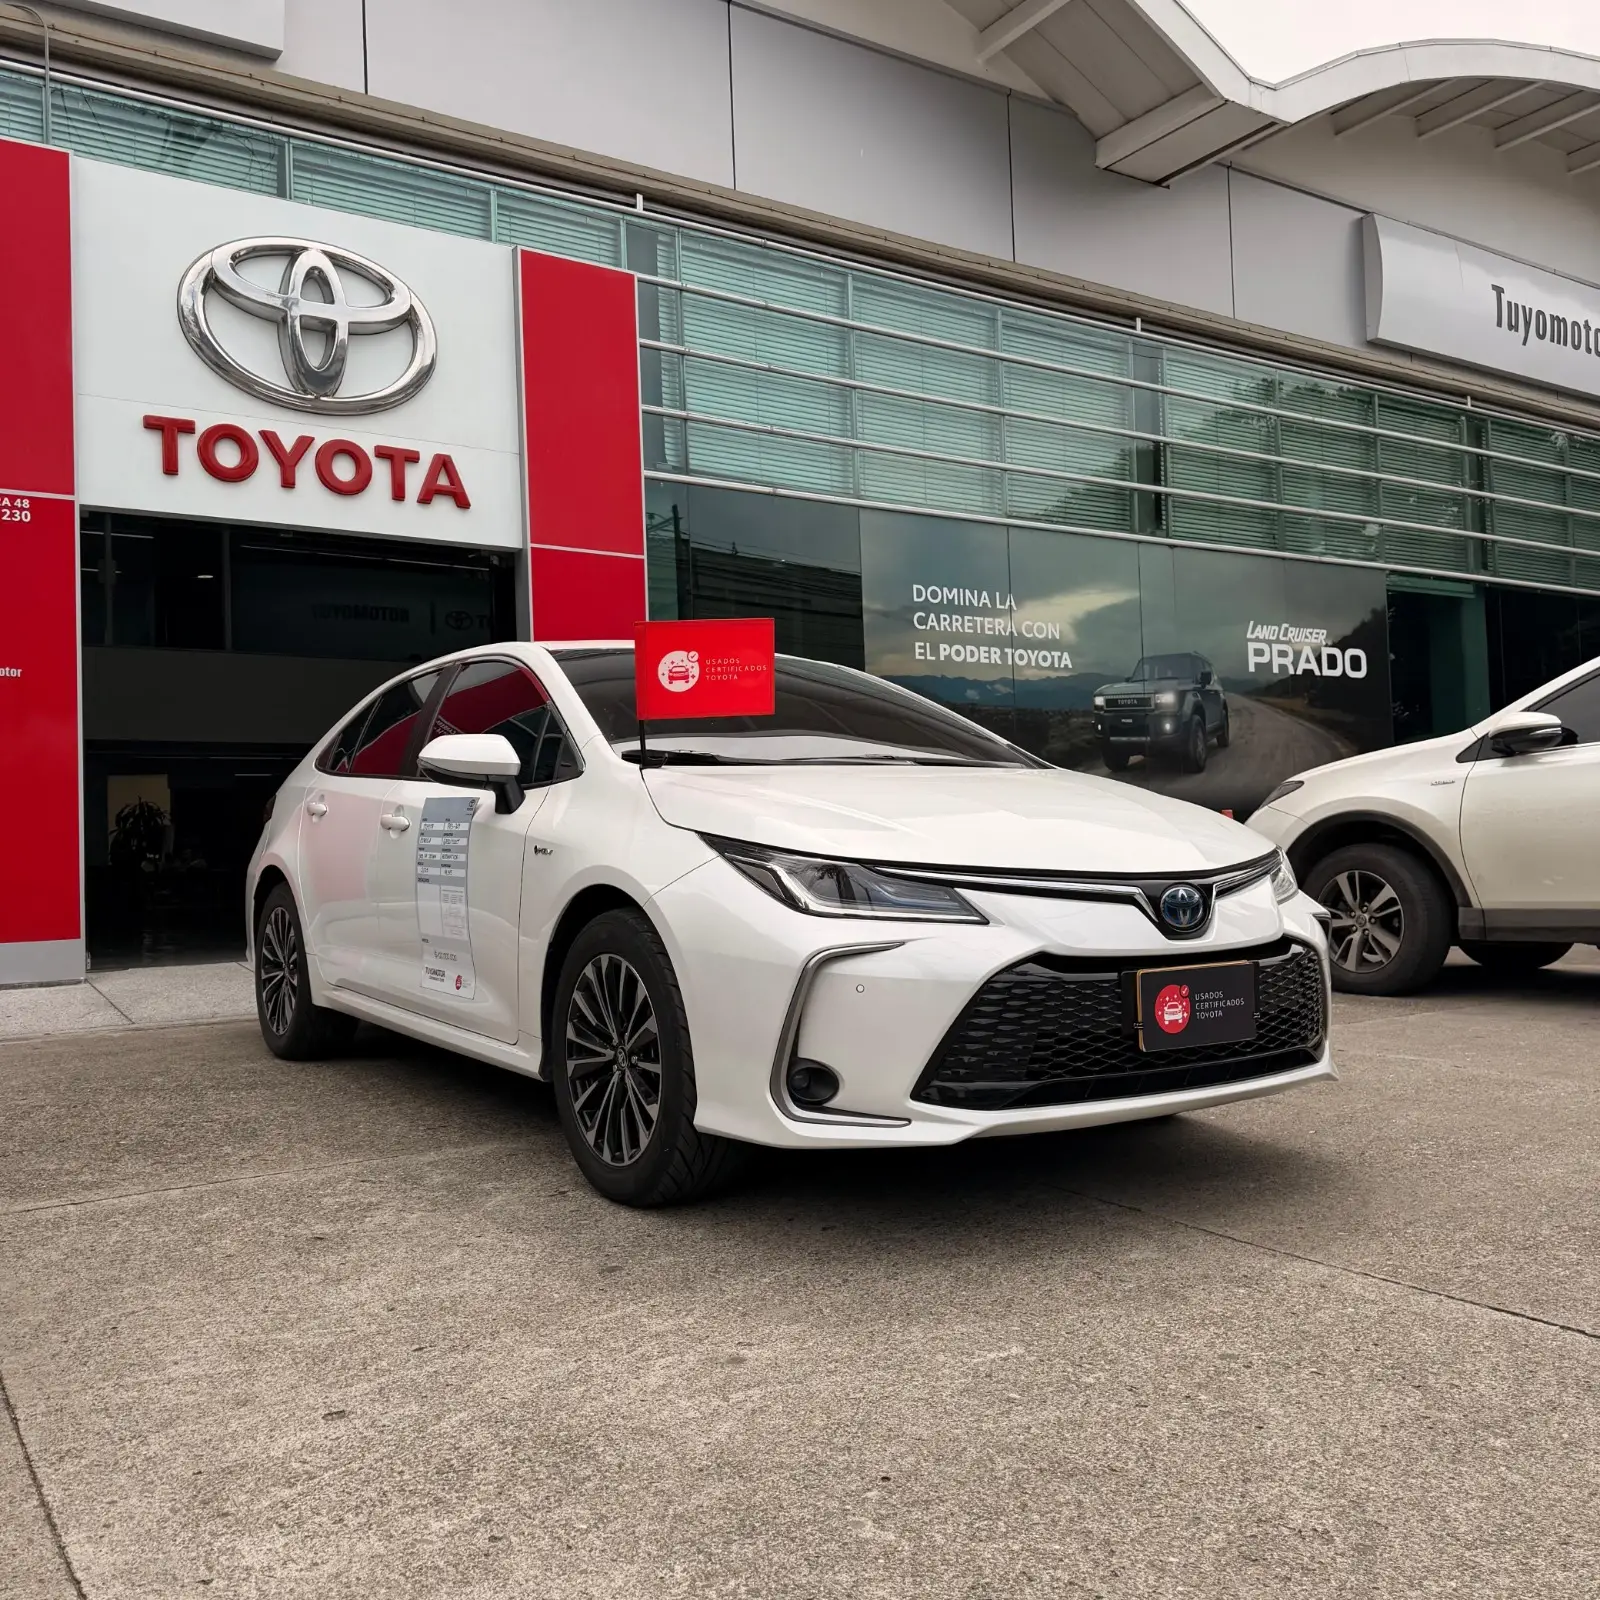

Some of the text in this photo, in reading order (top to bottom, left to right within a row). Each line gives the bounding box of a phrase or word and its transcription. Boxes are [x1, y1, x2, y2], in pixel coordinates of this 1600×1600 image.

[143, 414, 471, 509] TOYOTA
[14, 498, 30, 509] 48
[1, 508, 31, 523] 230
[912, 584, 1018, 611] DOMINA LA
[913, 612, 1061, 640] CARRETERA CON
[1246, 620, 1327, 645] LAND CRUISER
[705, 658, 740, 666] USADOS
[914, 642, 1073, 669] EL PODER TOYOTA
[1247, 641, 1368, 680] PRADO
[705, 665, 767, 673] CERTIFICADOS
[1195, 991, 1223, 1000] USADOS
[1195, 997, 1245, 1010] CERTIFICADOS
[1196, 1010, 1223, 1020] TOYOTA
